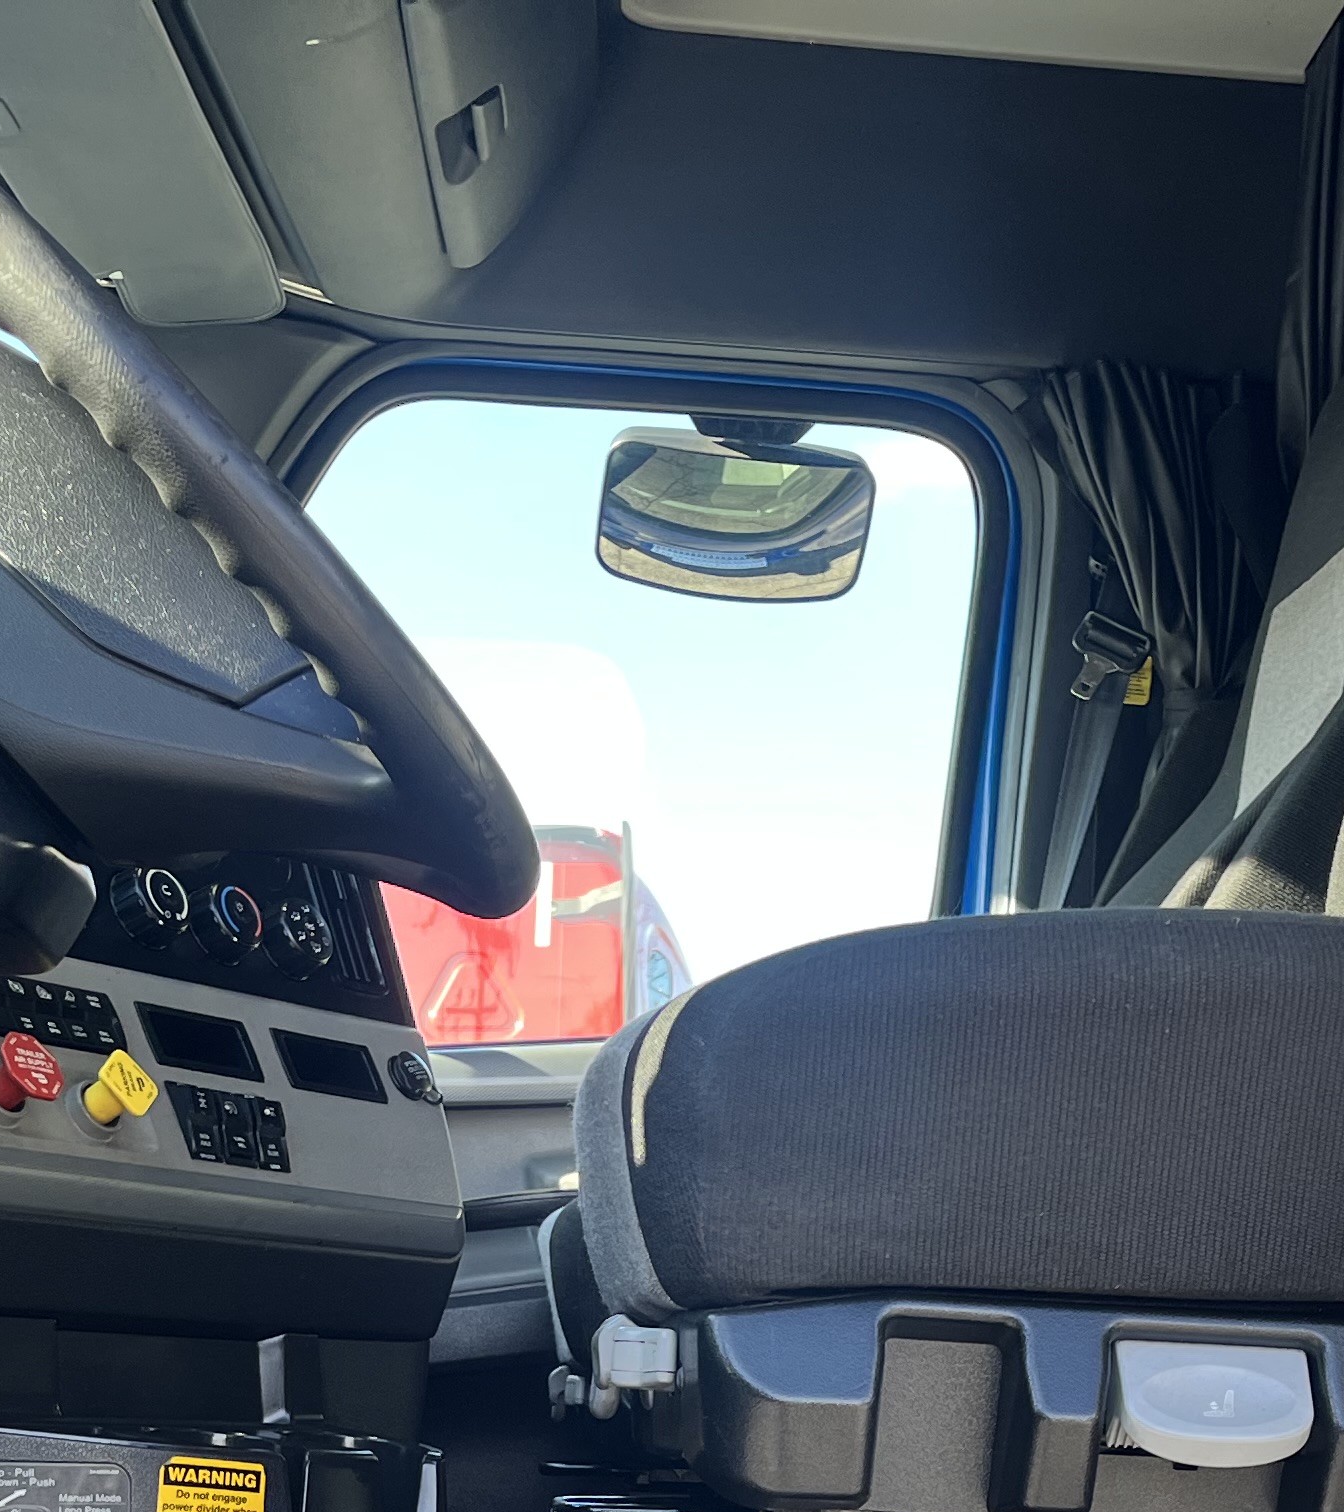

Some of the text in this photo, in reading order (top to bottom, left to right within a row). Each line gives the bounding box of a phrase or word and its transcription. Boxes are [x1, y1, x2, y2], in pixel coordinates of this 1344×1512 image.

[16, 1047, 46, 1060] TRAILER
[14, 1467, 35, 1477] Pull
[29, 1477, 56, 1487] Push
[168, 1466, 257, 1489] WARNING
[58, 1493, 122, 1503] Manual Mode
[176, 1489, 248, 1505] Do not engage
[162, 1503, 194, 1512] power
